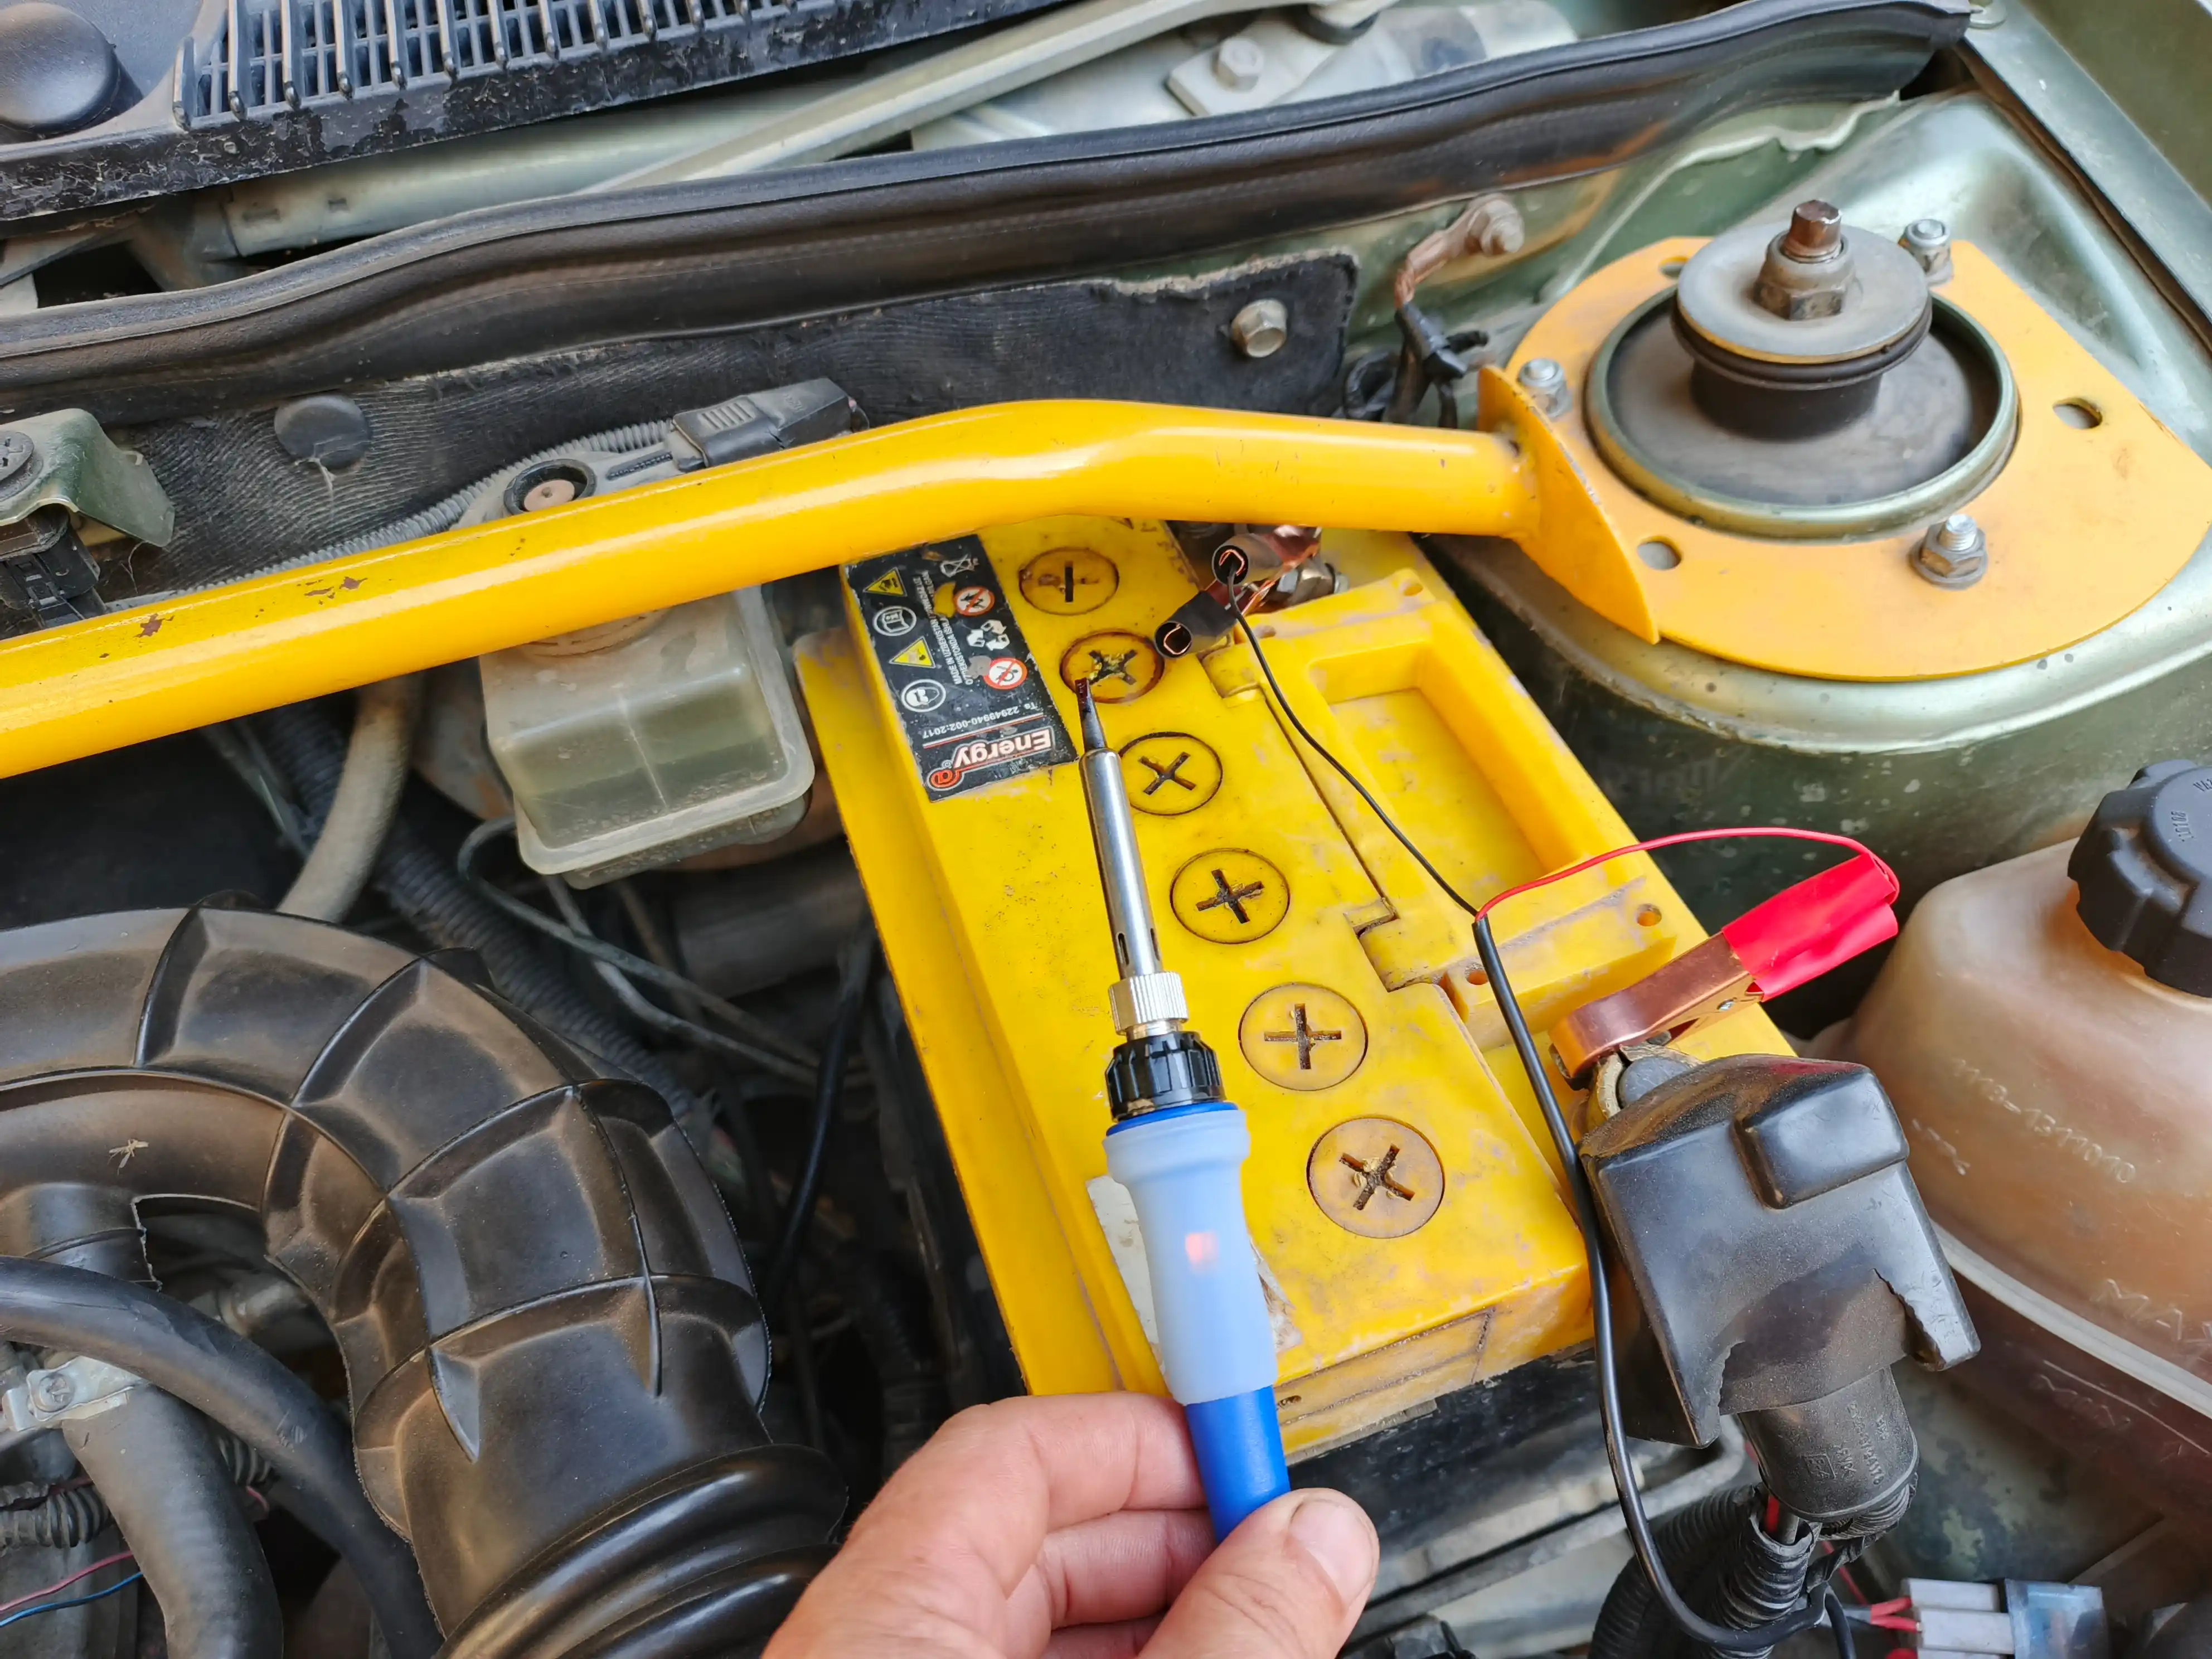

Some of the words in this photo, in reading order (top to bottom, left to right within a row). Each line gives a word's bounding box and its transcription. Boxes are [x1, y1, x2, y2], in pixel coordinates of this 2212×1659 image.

[930, 619, 952, 658] UZBEKISTAN
[949, 663, 963, 685] MADE
[953, 729, 1052, 768] Energy
